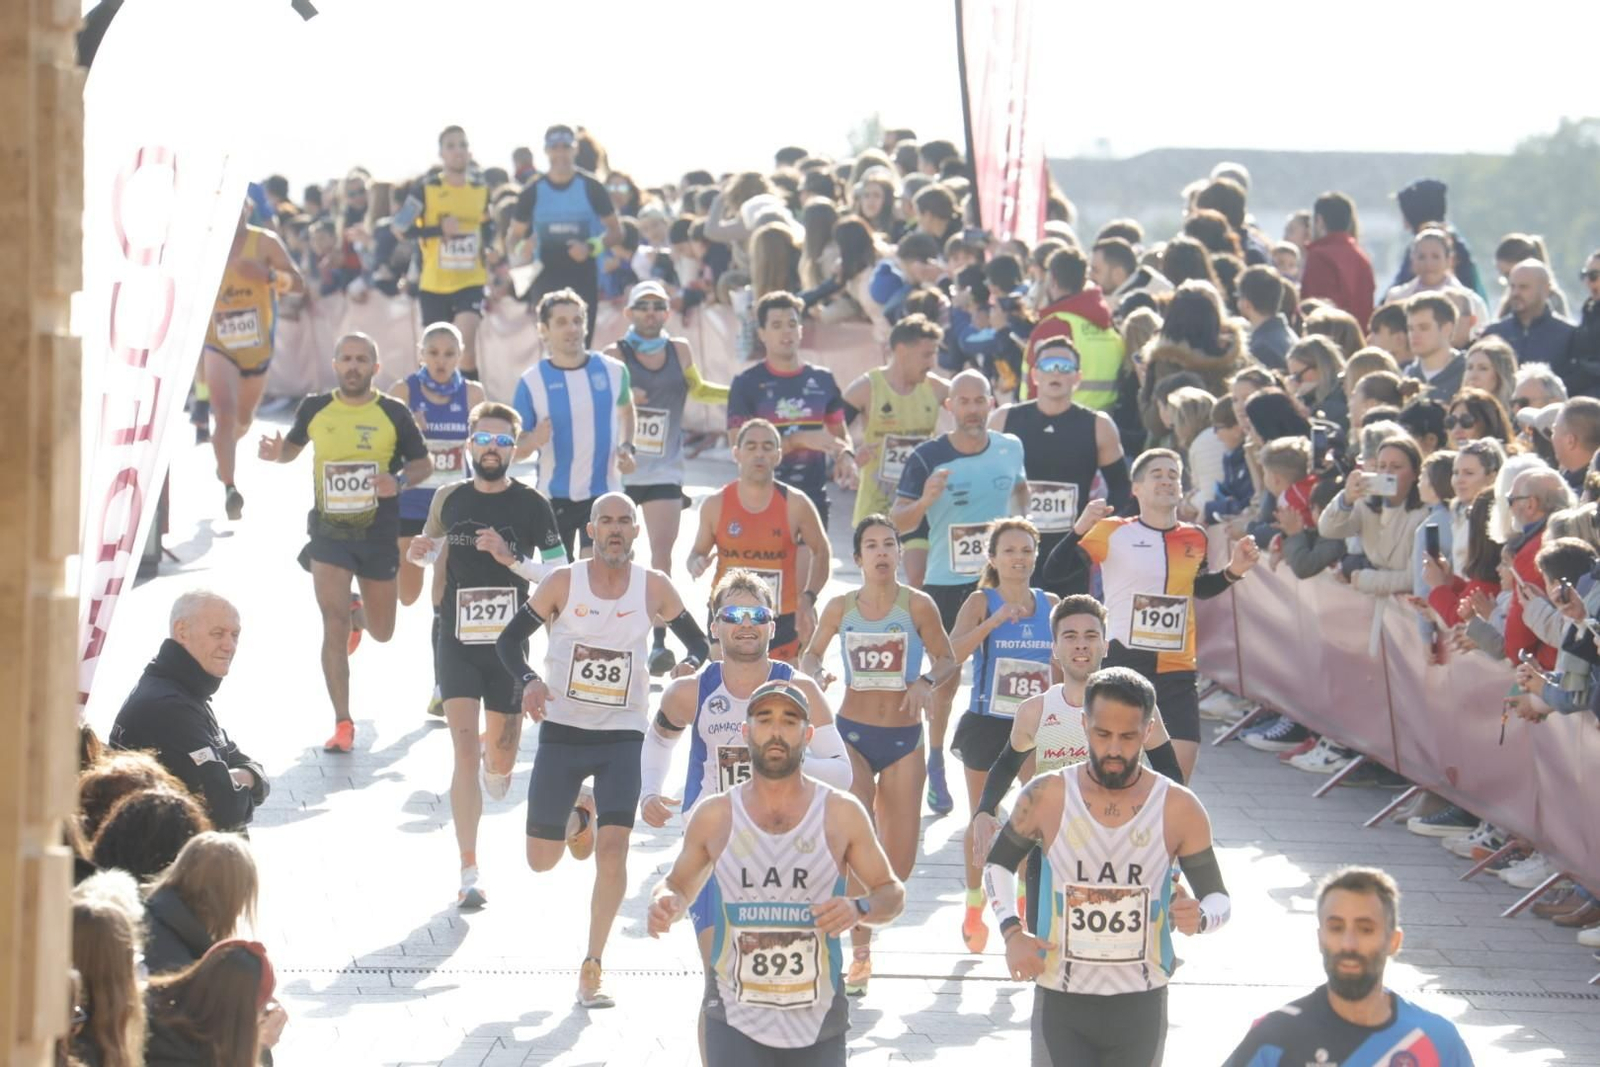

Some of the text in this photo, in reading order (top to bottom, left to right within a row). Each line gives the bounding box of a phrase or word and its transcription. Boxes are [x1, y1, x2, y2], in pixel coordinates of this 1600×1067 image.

[637, 422, 659, 436] 10
[329, 476, 372, 491] 1006
[1031, 497, 1067, 513] 2811
[464, 603, 508, 621] 1297
[1141, 609, 1181, 629] 1901
[858, 651, 894, 669] 199
[581, 662, 622, 683] 638
[1009, 677, 1041, 697] 185
[726, 765, 752, 786] 15
[741, 866, 809, 890] LAR
[1076, 860, 1143, 886] LAR
[738, 907, 811, 922] RUNNING
[1071, 908, 1142, 934] 3063
[751, 952, 804, 976] 893
